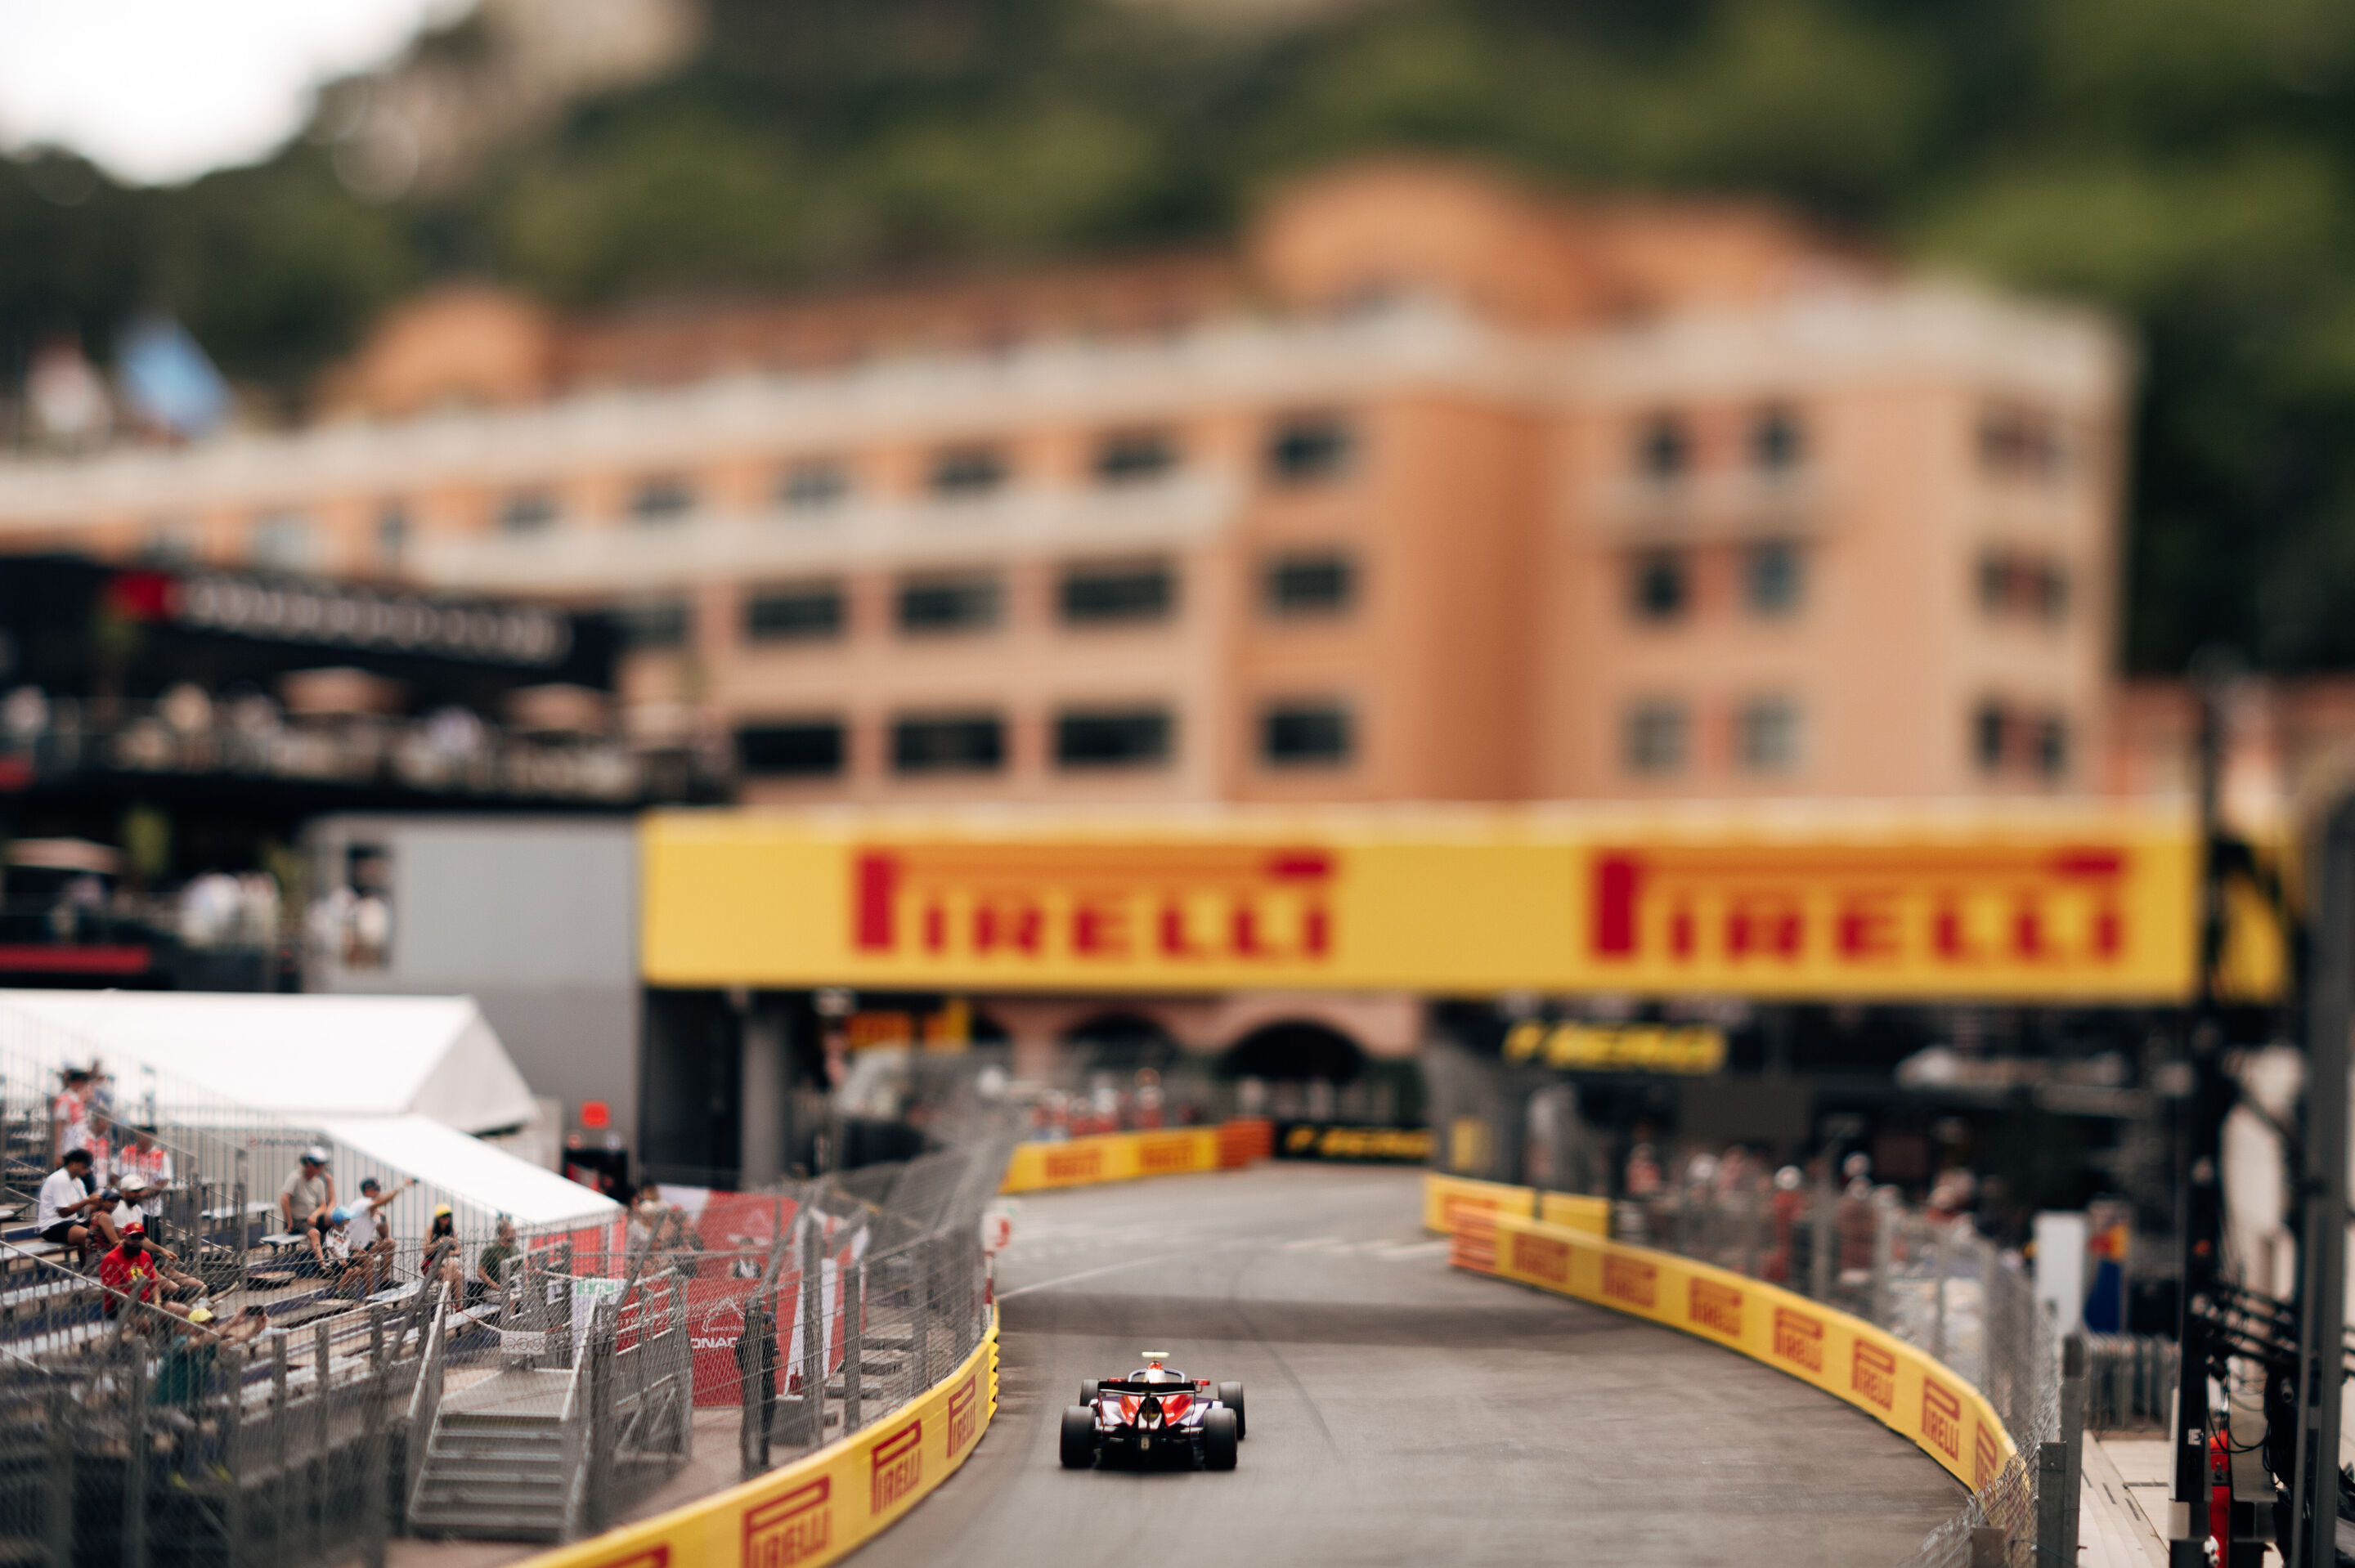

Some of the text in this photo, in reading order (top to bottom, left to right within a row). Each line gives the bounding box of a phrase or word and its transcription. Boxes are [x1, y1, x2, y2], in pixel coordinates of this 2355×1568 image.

[852, 846, 1338, 960] PIRELLI
[1589, 846, 2131, 963] PIRELLI
[1774, 1306, 1823, 1373] PIRELLI
[1851, 1337, 1896, 1412] PIRELLI
[946, 1374, 976, 1459] PIRELLI
[1922, 1377, 1961, 1463] PIRELLI
[871, 1418, 922, 1514] PIRELLI
[742, 1474, 831, 1568] PIRELLI
